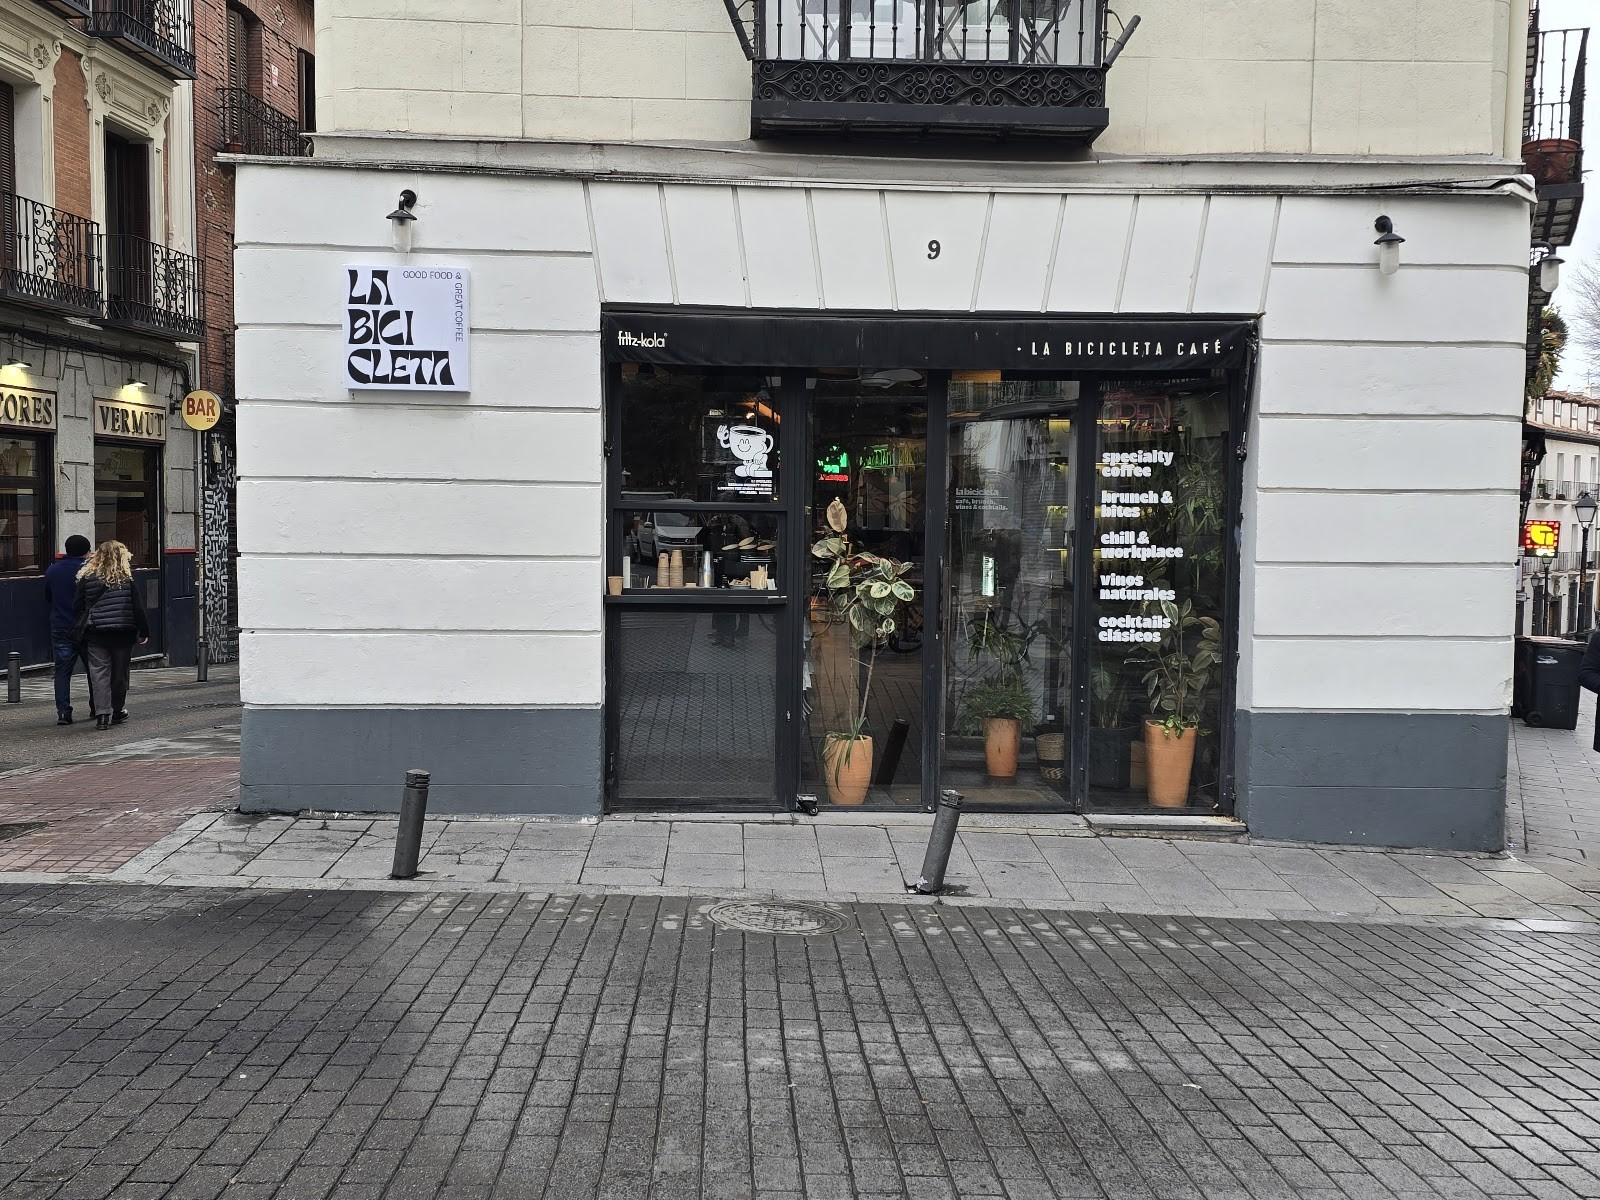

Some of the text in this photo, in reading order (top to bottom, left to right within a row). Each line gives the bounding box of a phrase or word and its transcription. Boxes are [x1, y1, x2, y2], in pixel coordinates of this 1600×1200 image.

[927, 239, 941, 260] 9
[403, 271, 462, 280] GOOD FOOD &
[348, 269, 393, 305] LA
[454, 282, 464, 342] GREAT COFFEE
[348, 309, 414, 345] BICI
[1031, 339, 1221, 356] LA BICICLETA CAFÉ
[348, 349, 455, 385] CLETA
[186, 397, 216, 416] BAR
[100, 405, 163, 437] VERMUT
[1102, 450, 1174, 466] specialty
[1102, 465, 1152, 478] coffee
[1101, 491, 1173, 504] brunch &
[1101, 505, 1140, 518] bites
[1101, 531, 1149, 544] chill &
[1101, 545, 1184, 561] workplace
[1100, 573, 1144, 586] vinos
[1100, 587, 1175, 600] naturales
[1099, 615, 1171, 628] cocktails
[1099, 629, 1161, 642] clásicos
